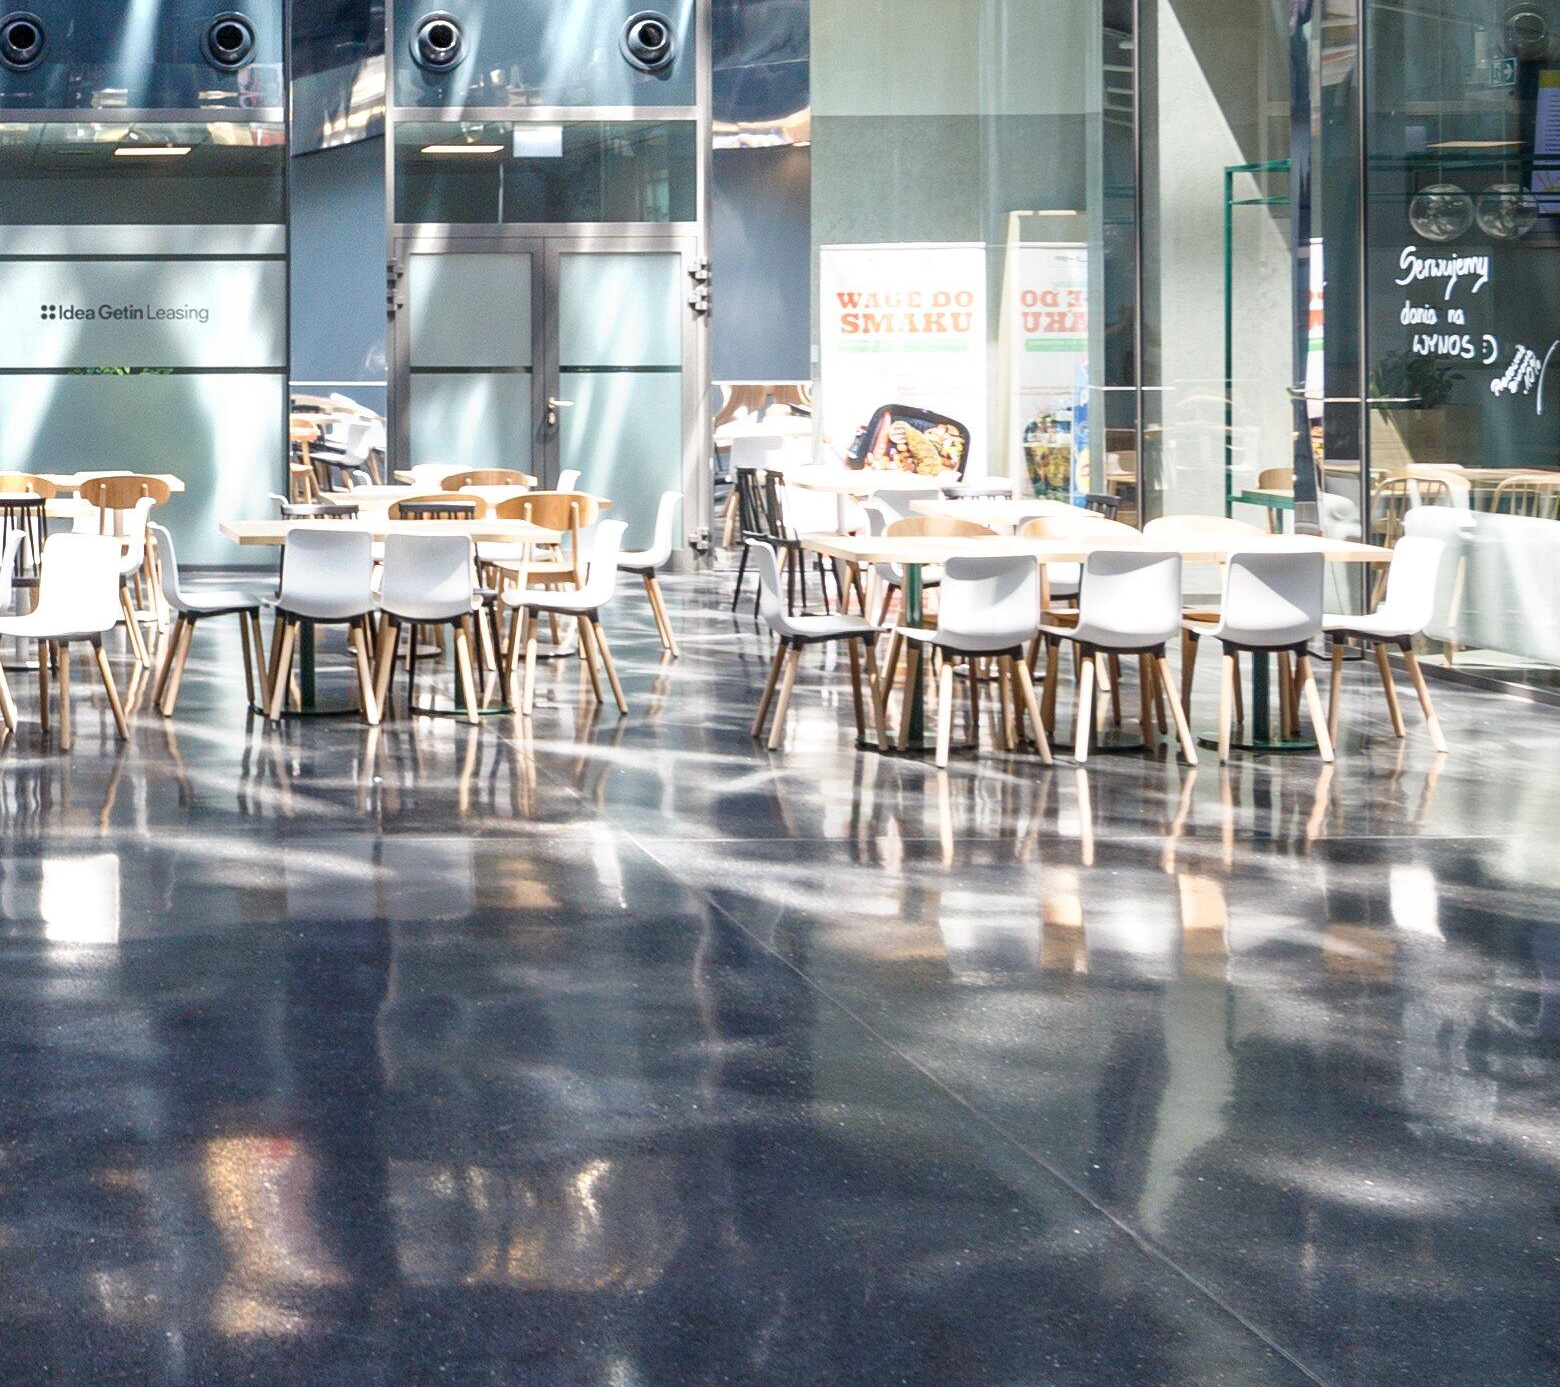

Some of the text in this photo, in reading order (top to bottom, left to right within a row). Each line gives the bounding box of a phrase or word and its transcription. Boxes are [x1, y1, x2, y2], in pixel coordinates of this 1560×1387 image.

[1394, 245, 1489, 301] Serwujemy
[931, 290, 975, 308] DO
[59, 304, 209, 324] Idea Getin Leasing
[840, 312, 974, 334] SMAKU
[1400, 299, 1465, 325] dania na
[1412, 333, 1475, 359] WYNOS
